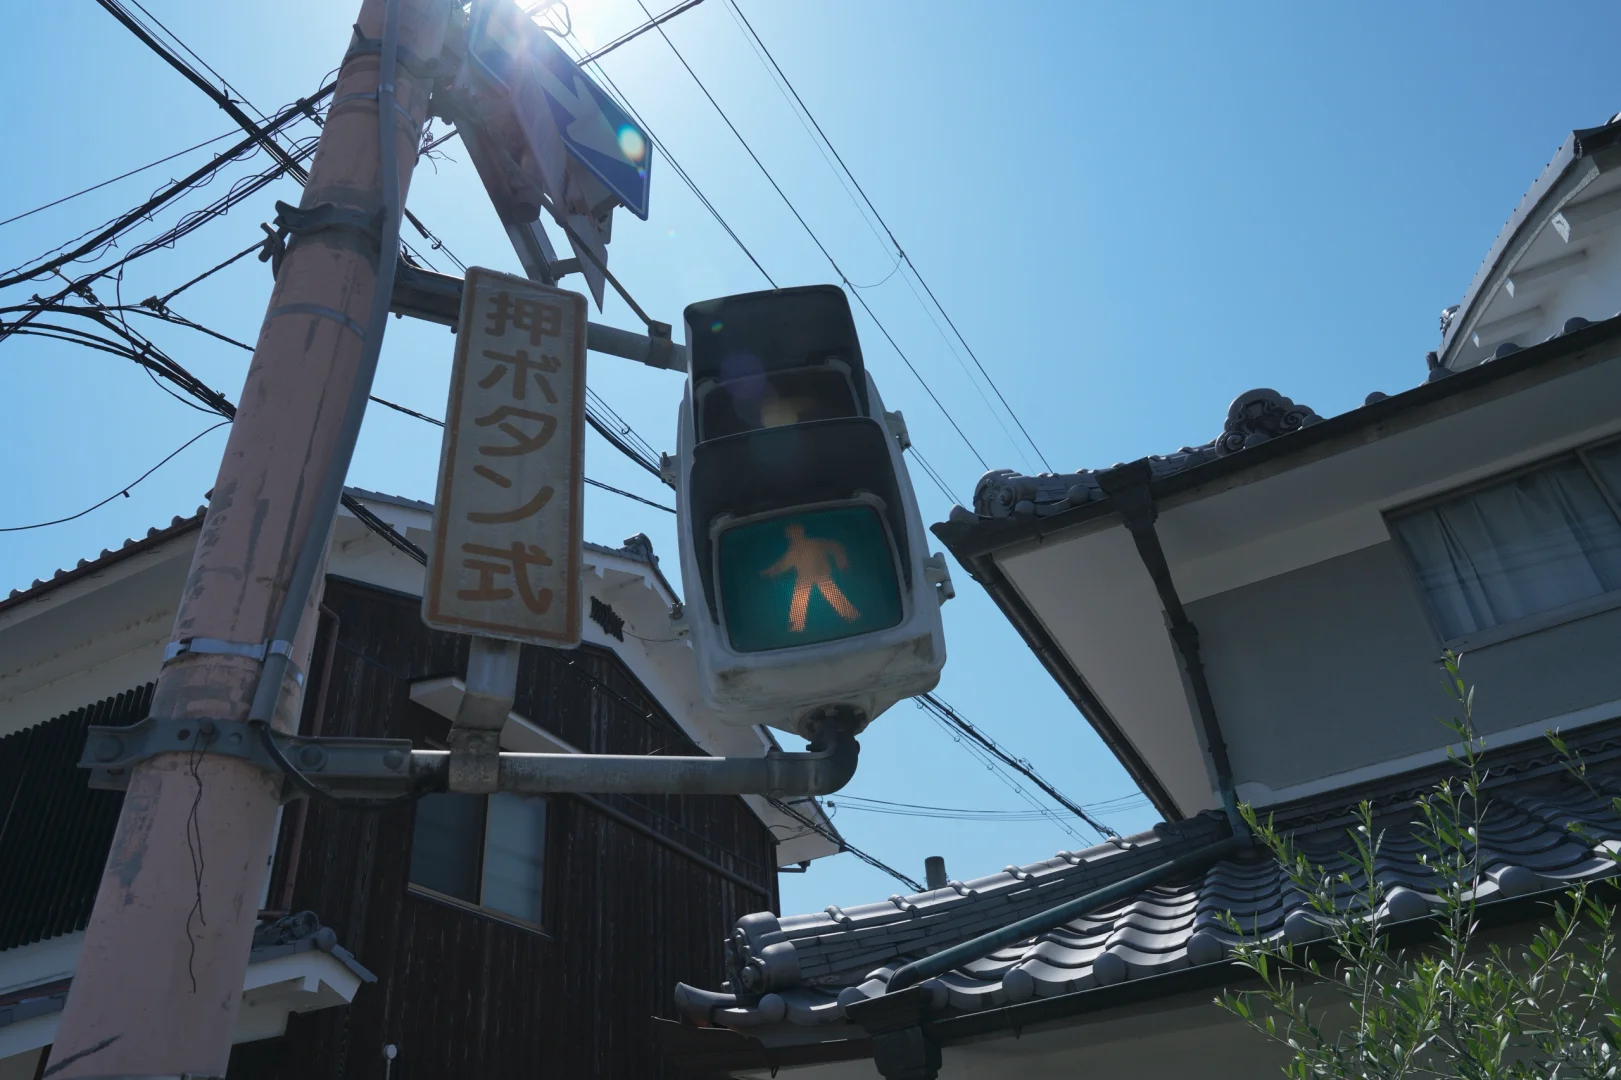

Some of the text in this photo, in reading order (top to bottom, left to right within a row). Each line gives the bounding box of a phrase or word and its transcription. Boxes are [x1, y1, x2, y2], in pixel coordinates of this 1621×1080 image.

[457, 292, 562, 615] 押ボタン式
